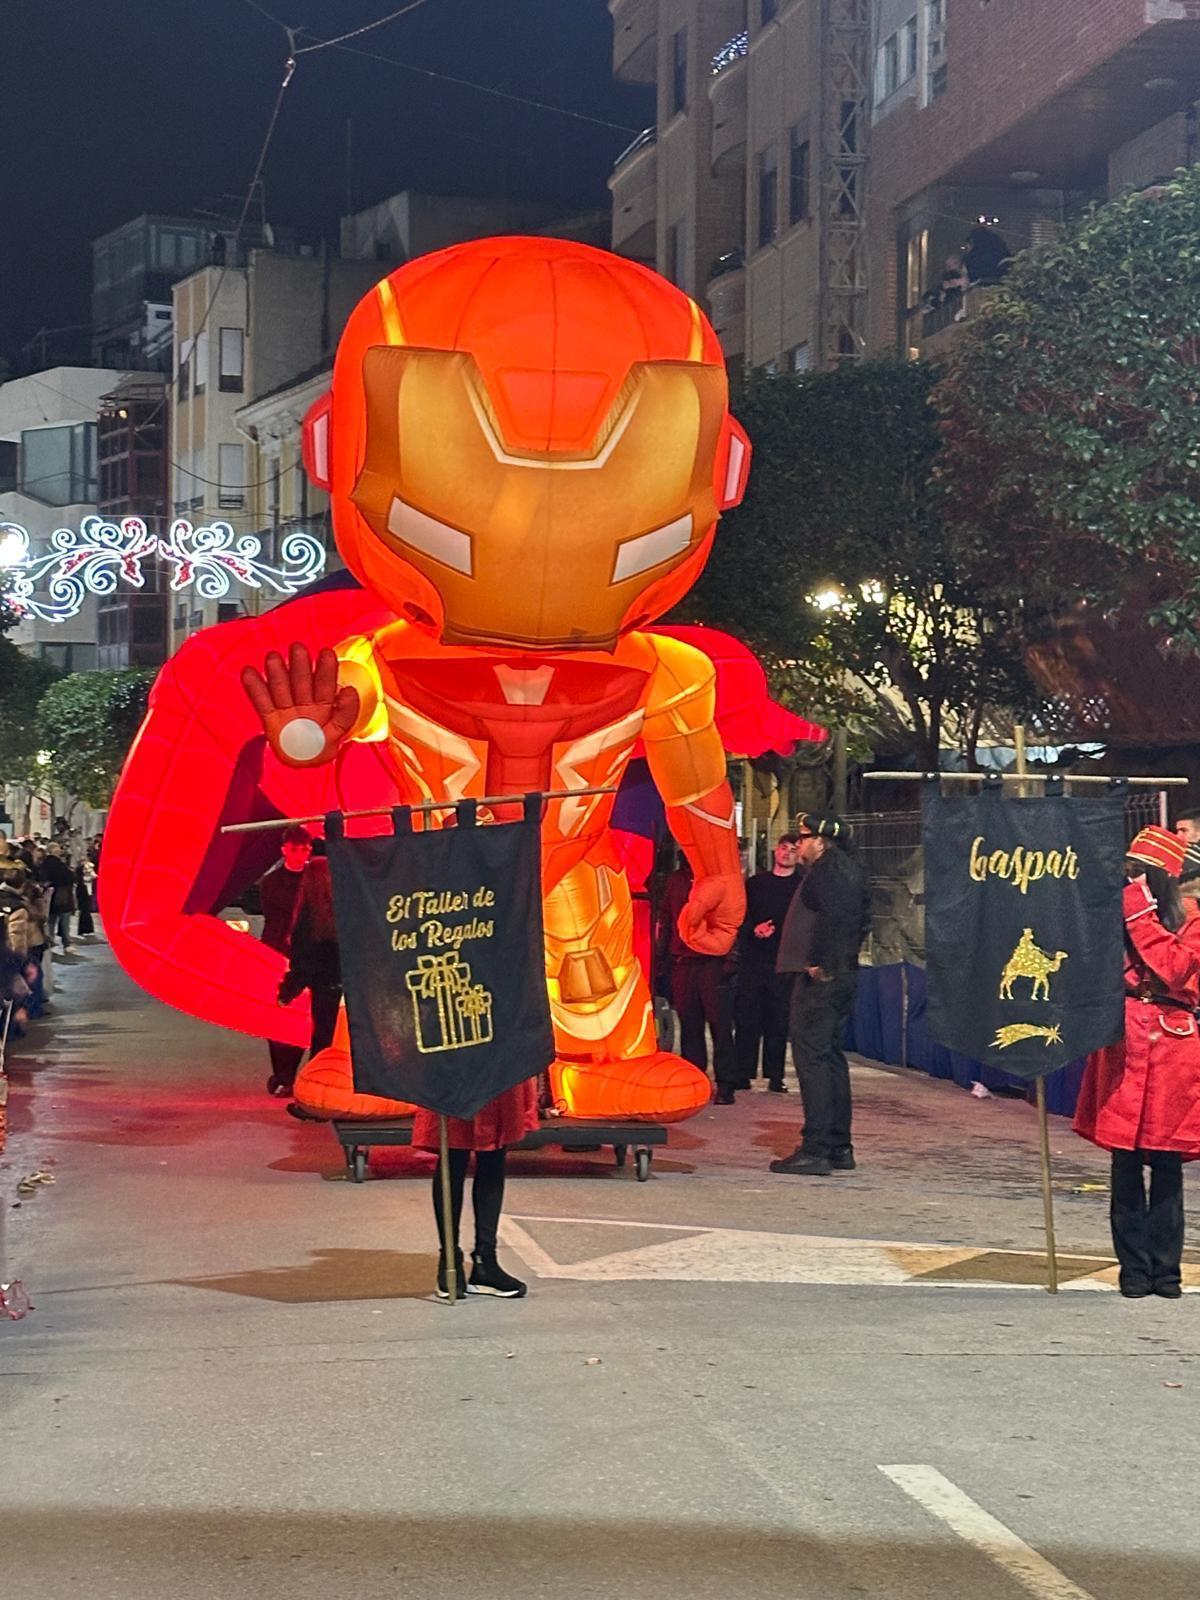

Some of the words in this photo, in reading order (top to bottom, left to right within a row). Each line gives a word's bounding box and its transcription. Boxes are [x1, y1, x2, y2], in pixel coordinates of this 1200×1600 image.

[969, 836, 1080, 895] Gaspar
[386, 894, 411, 923] El
[412, 891, 469, 919] Taller
[473, 886, 495, 908] de
[391, 929, 417, 951] los
[419, 917, 494, 949] Regalos
